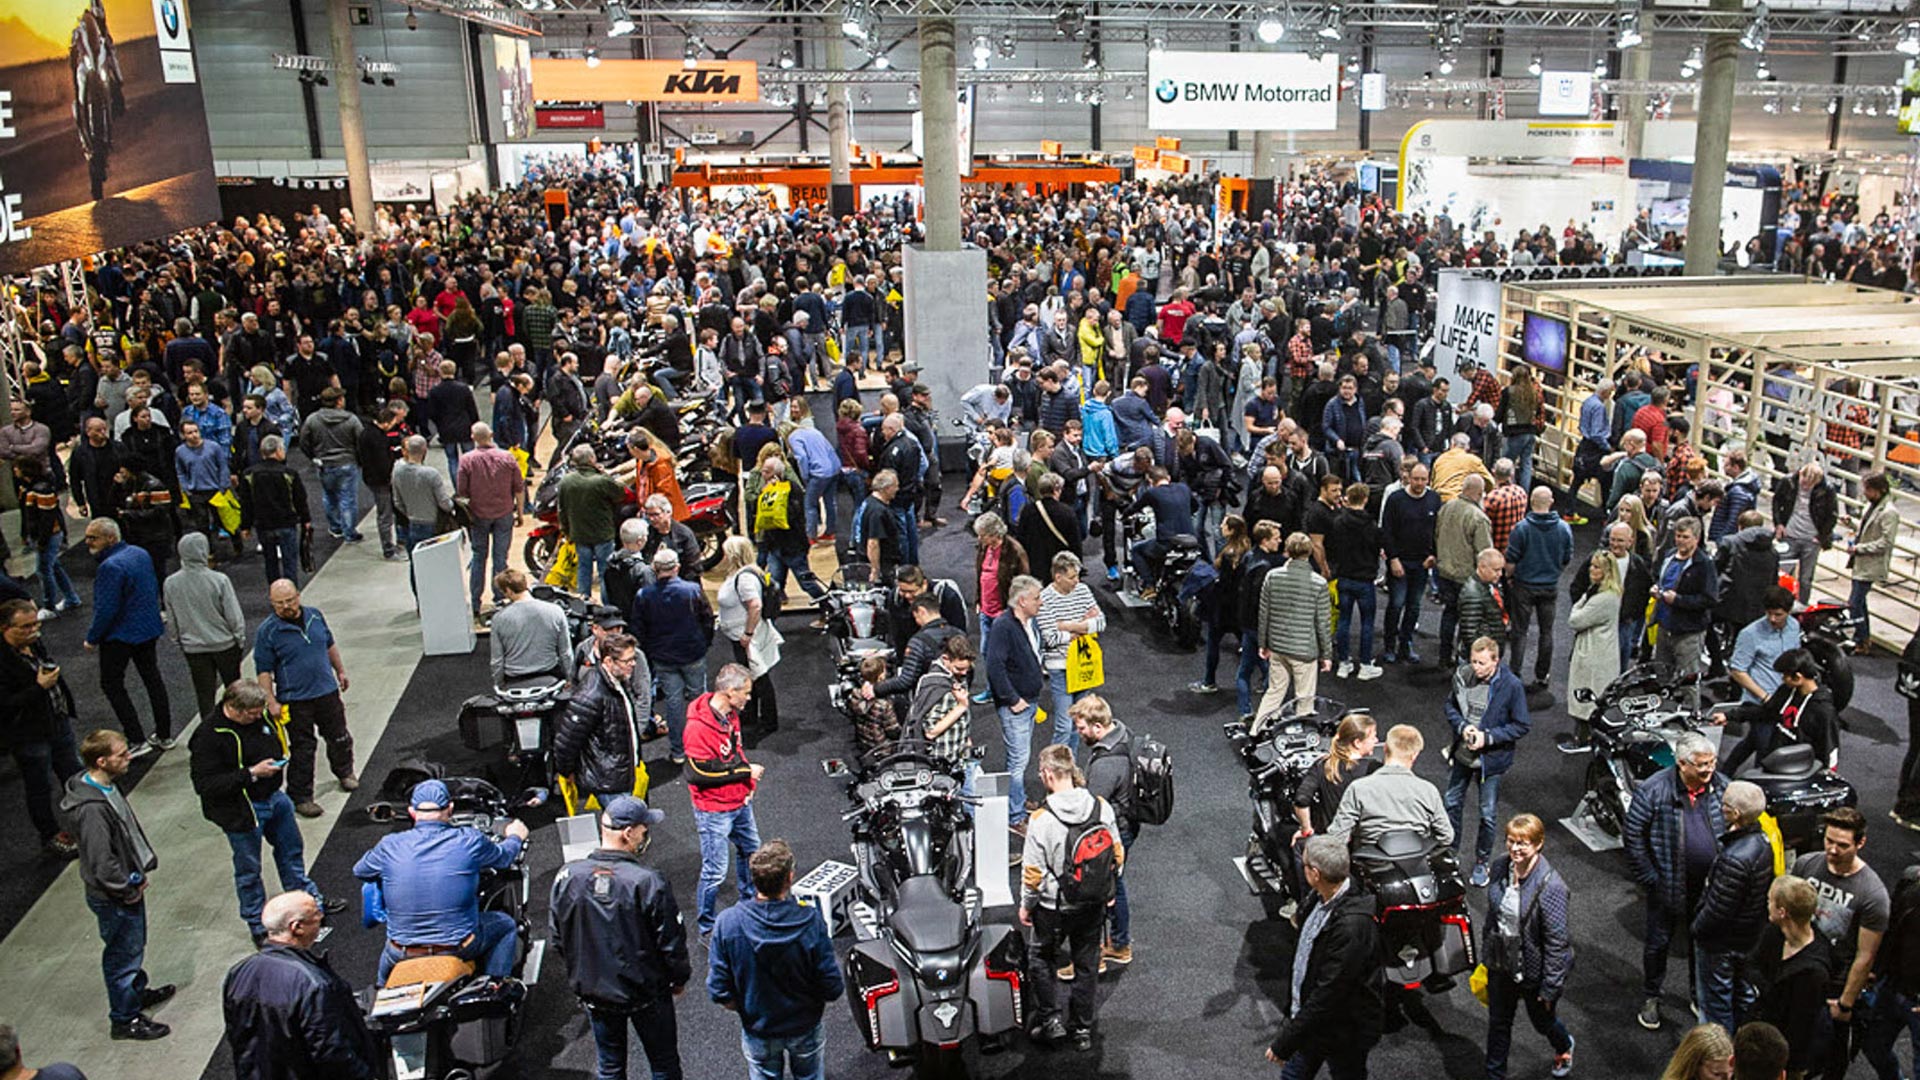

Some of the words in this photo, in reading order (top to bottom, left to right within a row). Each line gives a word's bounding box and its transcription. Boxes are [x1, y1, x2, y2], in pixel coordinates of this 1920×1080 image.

[663, 69, 741, 94] KTM
[1184, 82, 1239, 102] BMW
[1244, 83, 1332, 103] Motorrad
[1454, 304, 1495, 336] MAKE
[1440, 324, 1468, 353] LIFE
[1468, 335, 1480, 358] A
[1646, 328, 1687, 349] MOTORRAD
